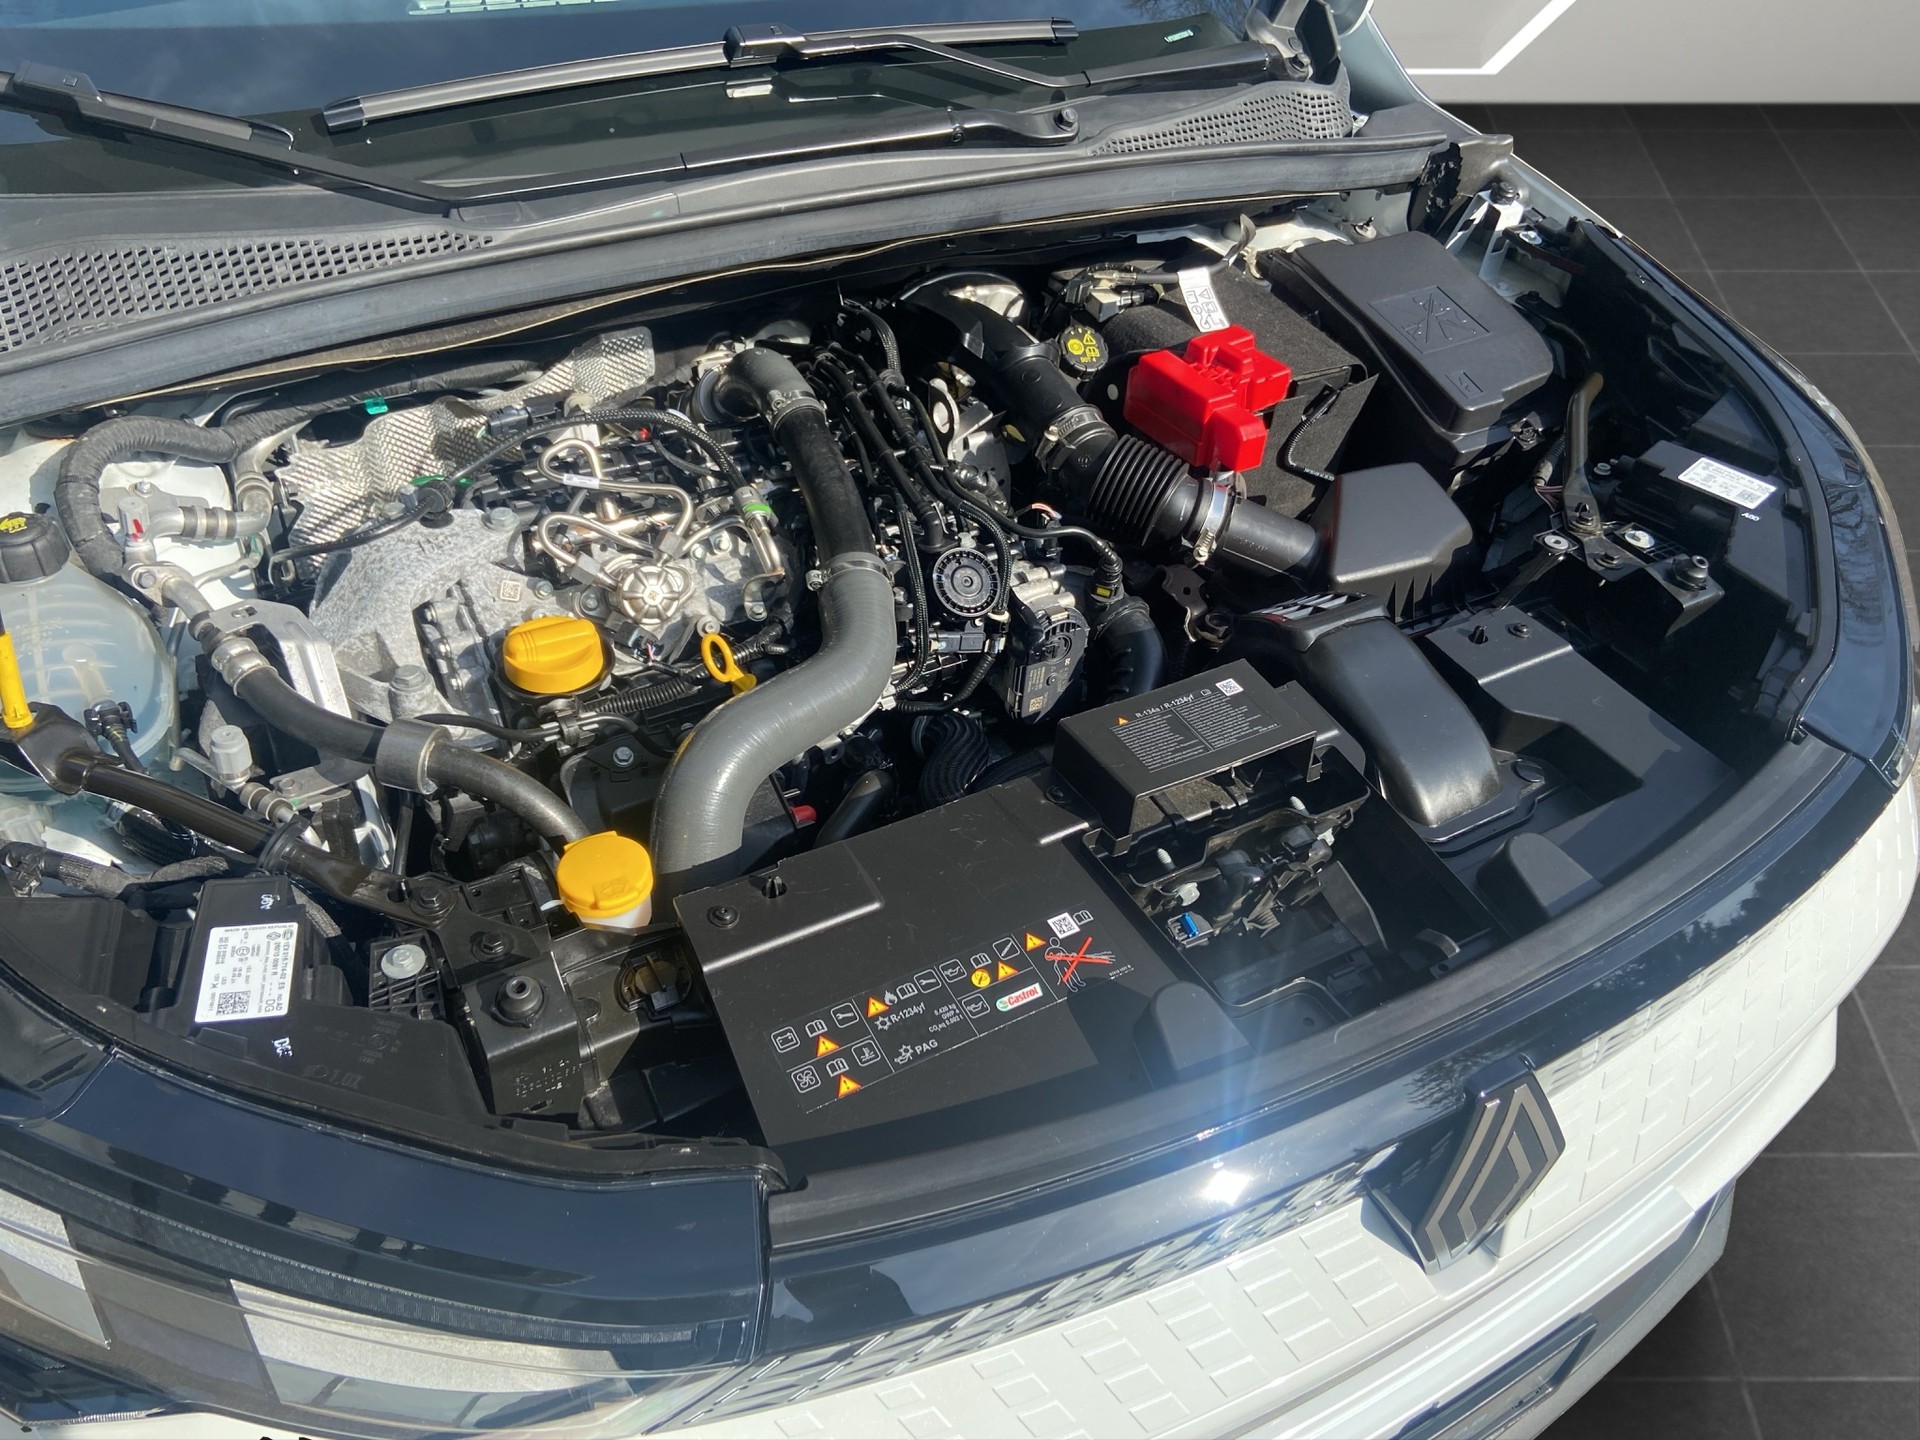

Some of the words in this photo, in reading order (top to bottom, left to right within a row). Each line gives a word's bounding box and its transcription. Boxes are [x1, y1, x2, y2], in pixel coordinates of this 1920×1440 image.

[1134, 707, 1161, 719] R-134a
[1163, 694, 1195, 709] R-1234yf
[264, 999, 275, 1013] DG
[1007, 986, 1039, 1006] Castrol
[890, 1002, 926, 1023] R-1234yf
[914, 1039, 938, 1055] PAG
